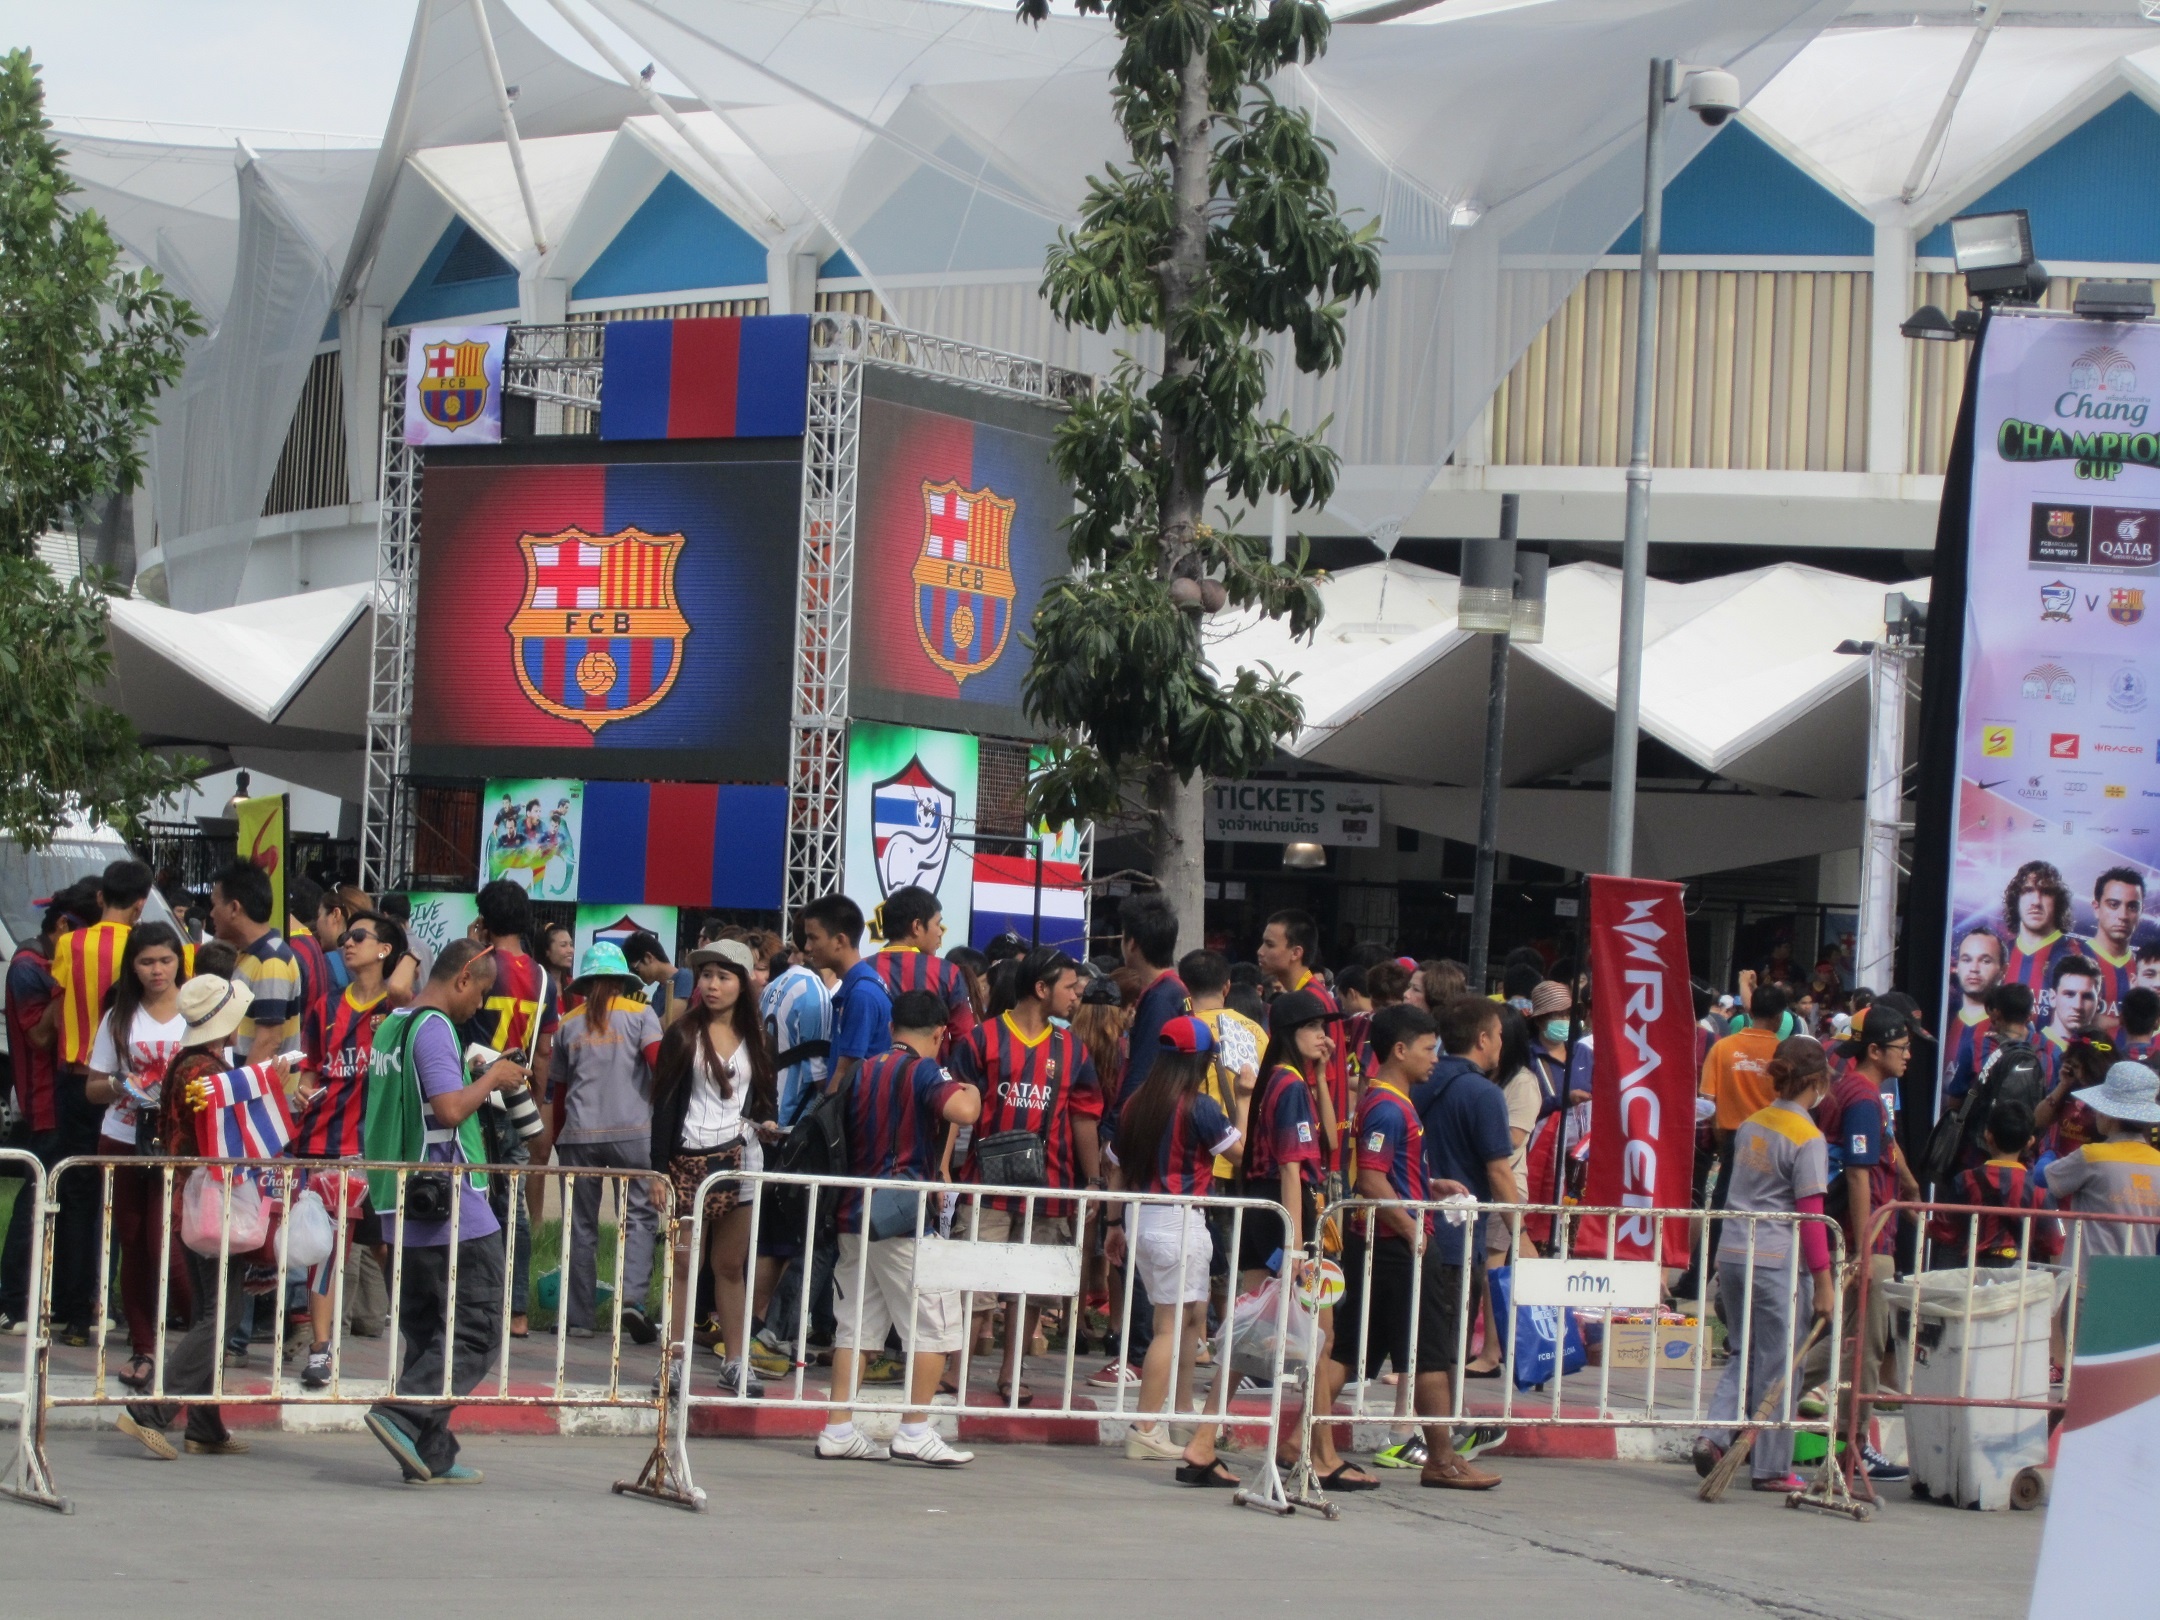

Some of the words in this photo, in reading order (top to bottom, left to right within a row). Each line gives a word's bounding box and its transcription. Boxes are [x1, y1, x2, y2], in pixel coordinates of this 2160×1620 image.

[440, 377, 466, 389] FCB
[2054, 391, 2150, 428] Chang
[2075, 459, 2123, 481] CUP
[2100, 541, 2152, 556] QATAR
[946, 563, 984, 591] FCB
[565, 611, 631, 635] FCB
[1213, 784, 1325, 814] TICKETS
[2018, 788, 2048, 797] QATAR
[1218, 814, 1320, 836] จุดจำหน่ายบัตร
[323, 1046, 369, 1071] QATA
[997, 1081, 1052, 1100] QATAR
[260, 1174, 299, 1190] Chag
